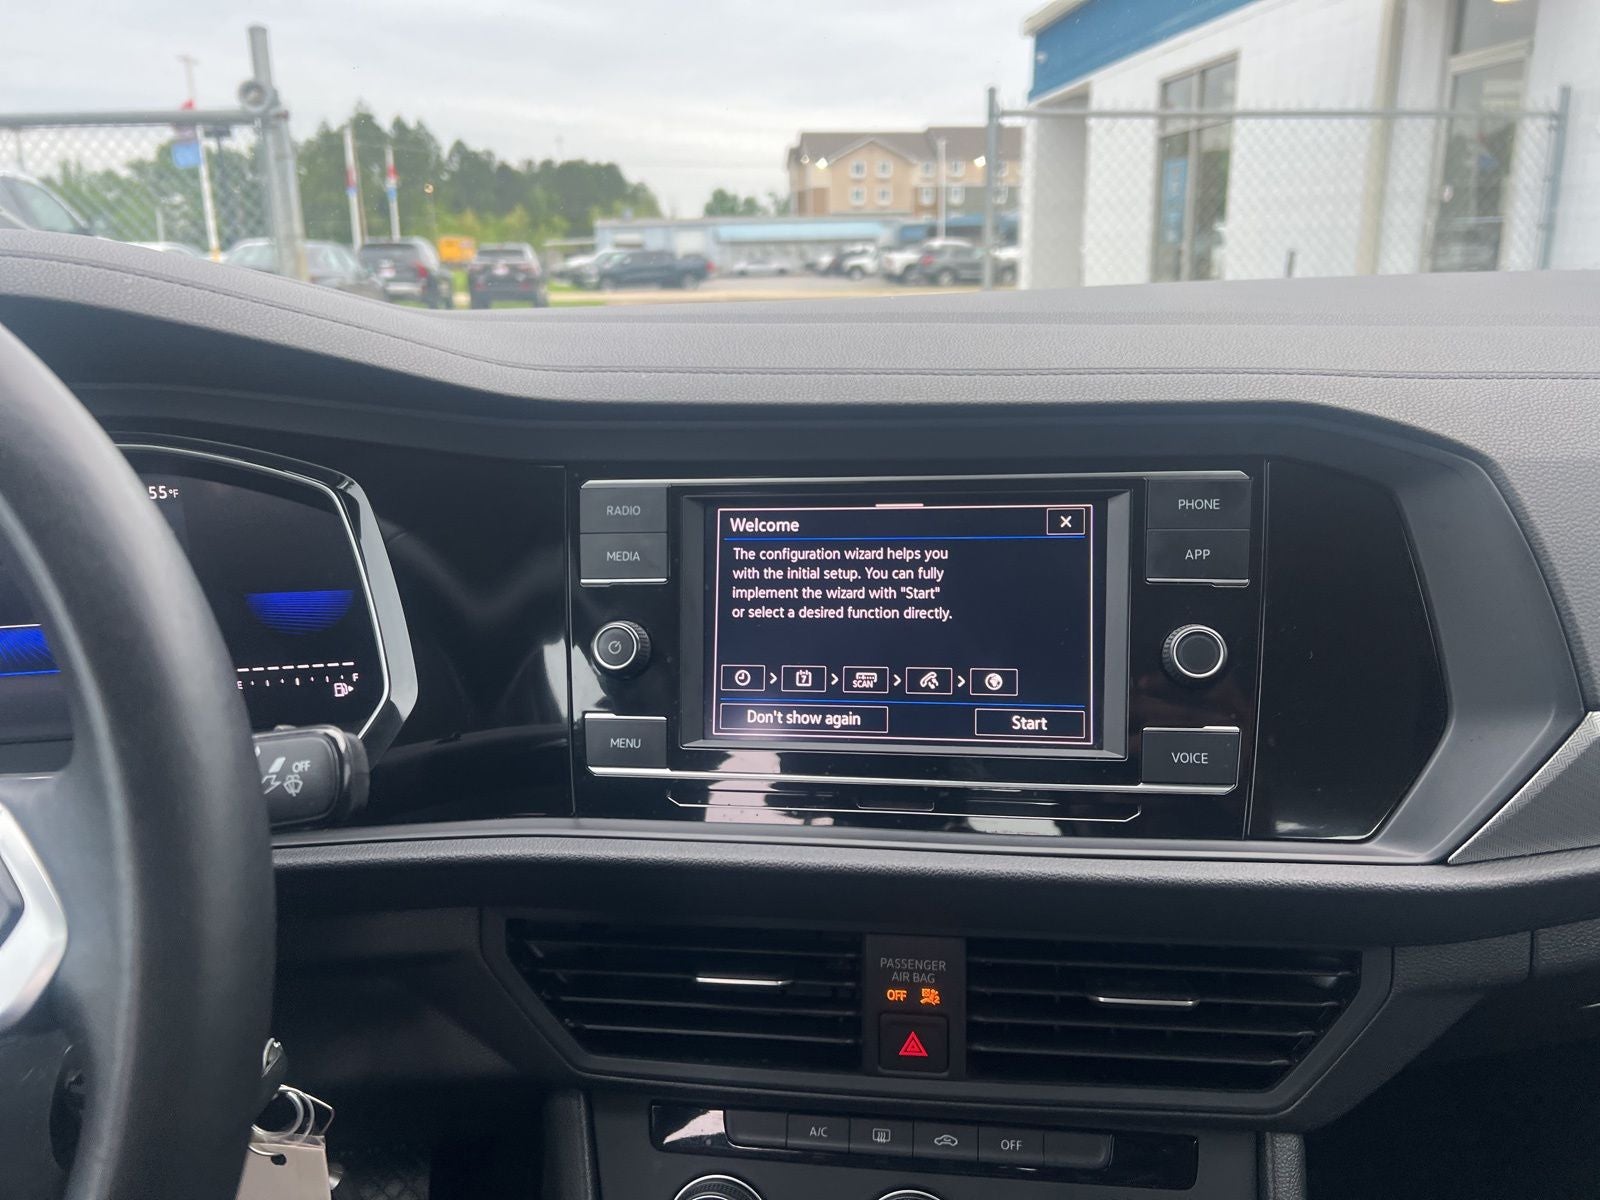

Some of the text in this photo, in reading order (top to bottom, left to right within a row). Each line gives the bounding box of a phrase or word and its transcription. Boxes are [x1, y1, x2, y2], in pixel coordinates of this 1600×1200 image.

[606, 505, 641, 516] RADIO
[1178, 498, 1221, 511] PHONE
[729, 517, 800, 533] Welcome
[606, 550, 641, 562] MEDIA
[733, 547, 949, 563] The configuration wizard helps you
[1185, 548, 1211, 561] APP
[732, 567, 944, 582] with the initial setup. You can fully
[732, 586, 941, 601] implement the wizard with "Start"
[731, 606, 953, 622] or select a desired function directly.
[352, 673, 359, 682] F
[852, 680, 874, 689] SCAN
[747, 709, 861, 727] Don't show again
[1011, 714, 1048, 731] Start
[610, 738, 642, 749] MENU
[1171, 752, 1209, 765] VOICE
[292, 760, 311, 773] OFF
[880, 957, 946, 972] PASSENGER
[891, 971, 936, 984] AIR BAG
[886, 989, 908, 1002] OFF
[809, 1126, 828, 1138] A/C
[1000, 1138, 1023, 1151] OFF
